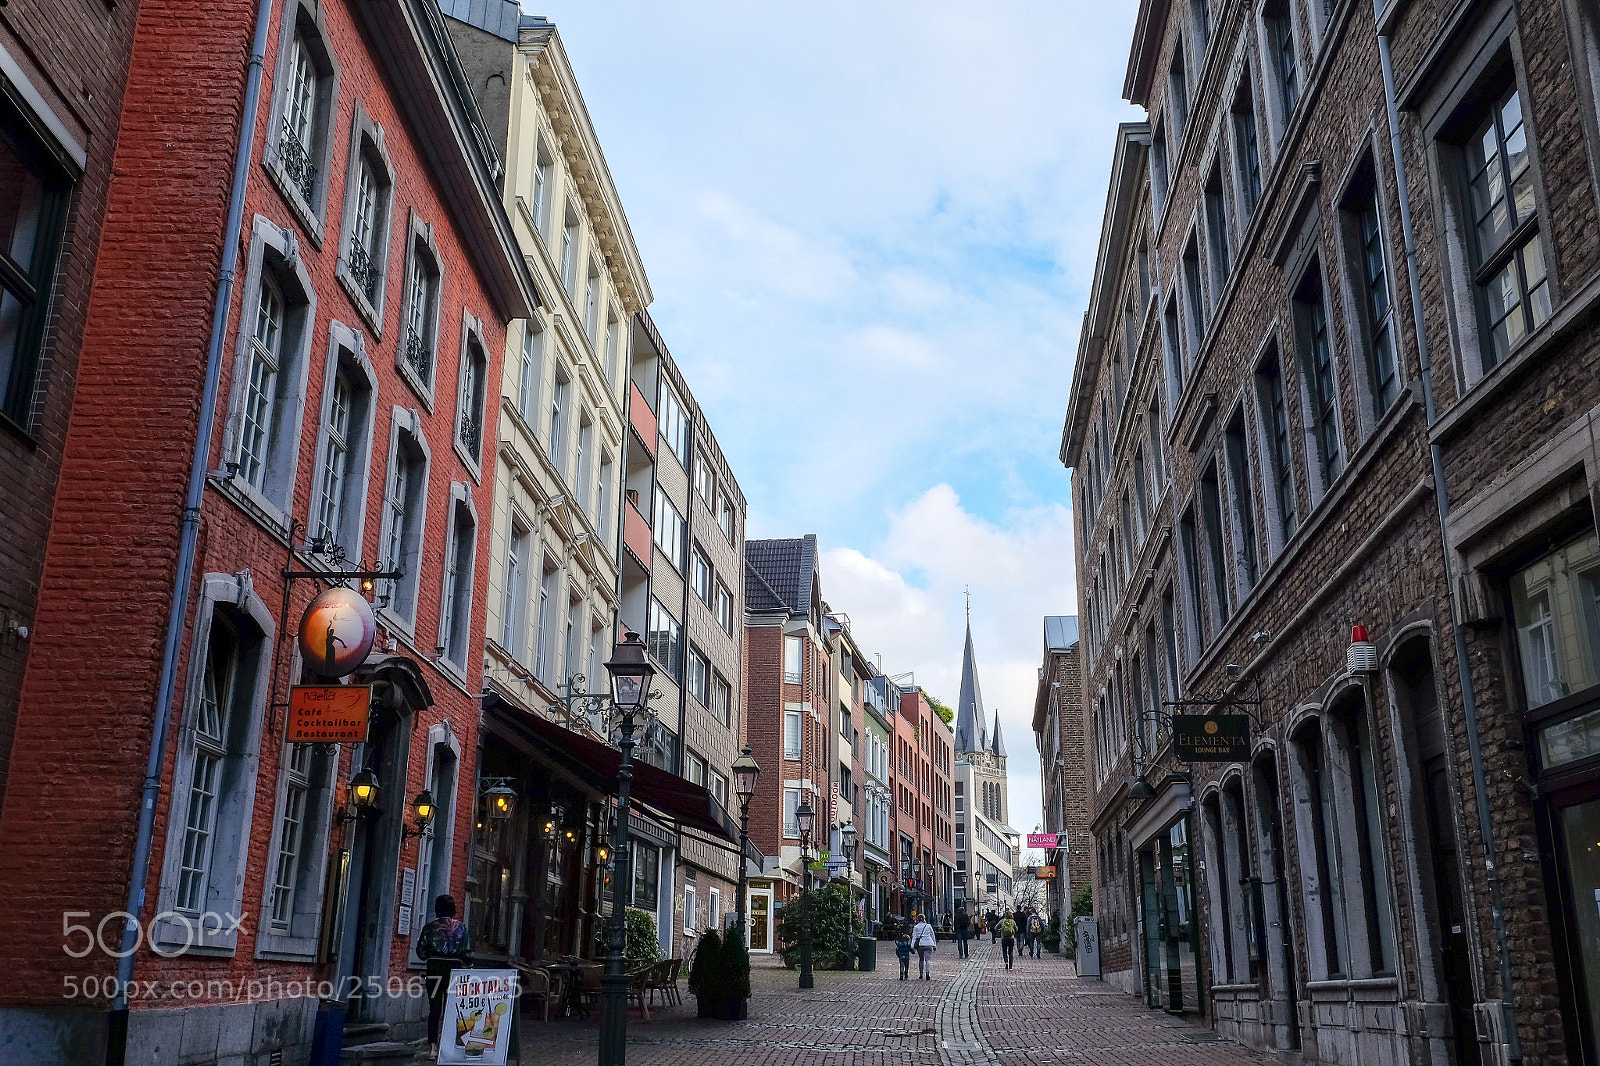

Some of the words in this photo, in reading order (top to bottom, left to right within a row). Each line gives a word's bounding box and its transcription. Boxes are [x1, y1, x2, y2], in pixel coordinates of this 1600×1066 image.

[297, 719, 362, 727] Cocktailbar
[296, 730, 359, 738] Restaurant
[1178, 733, 1246, 746] ELEMENTA
[830, 782, 839, 823] OUTDOOR
[455, 979, 510, 998] COCKTAILS
